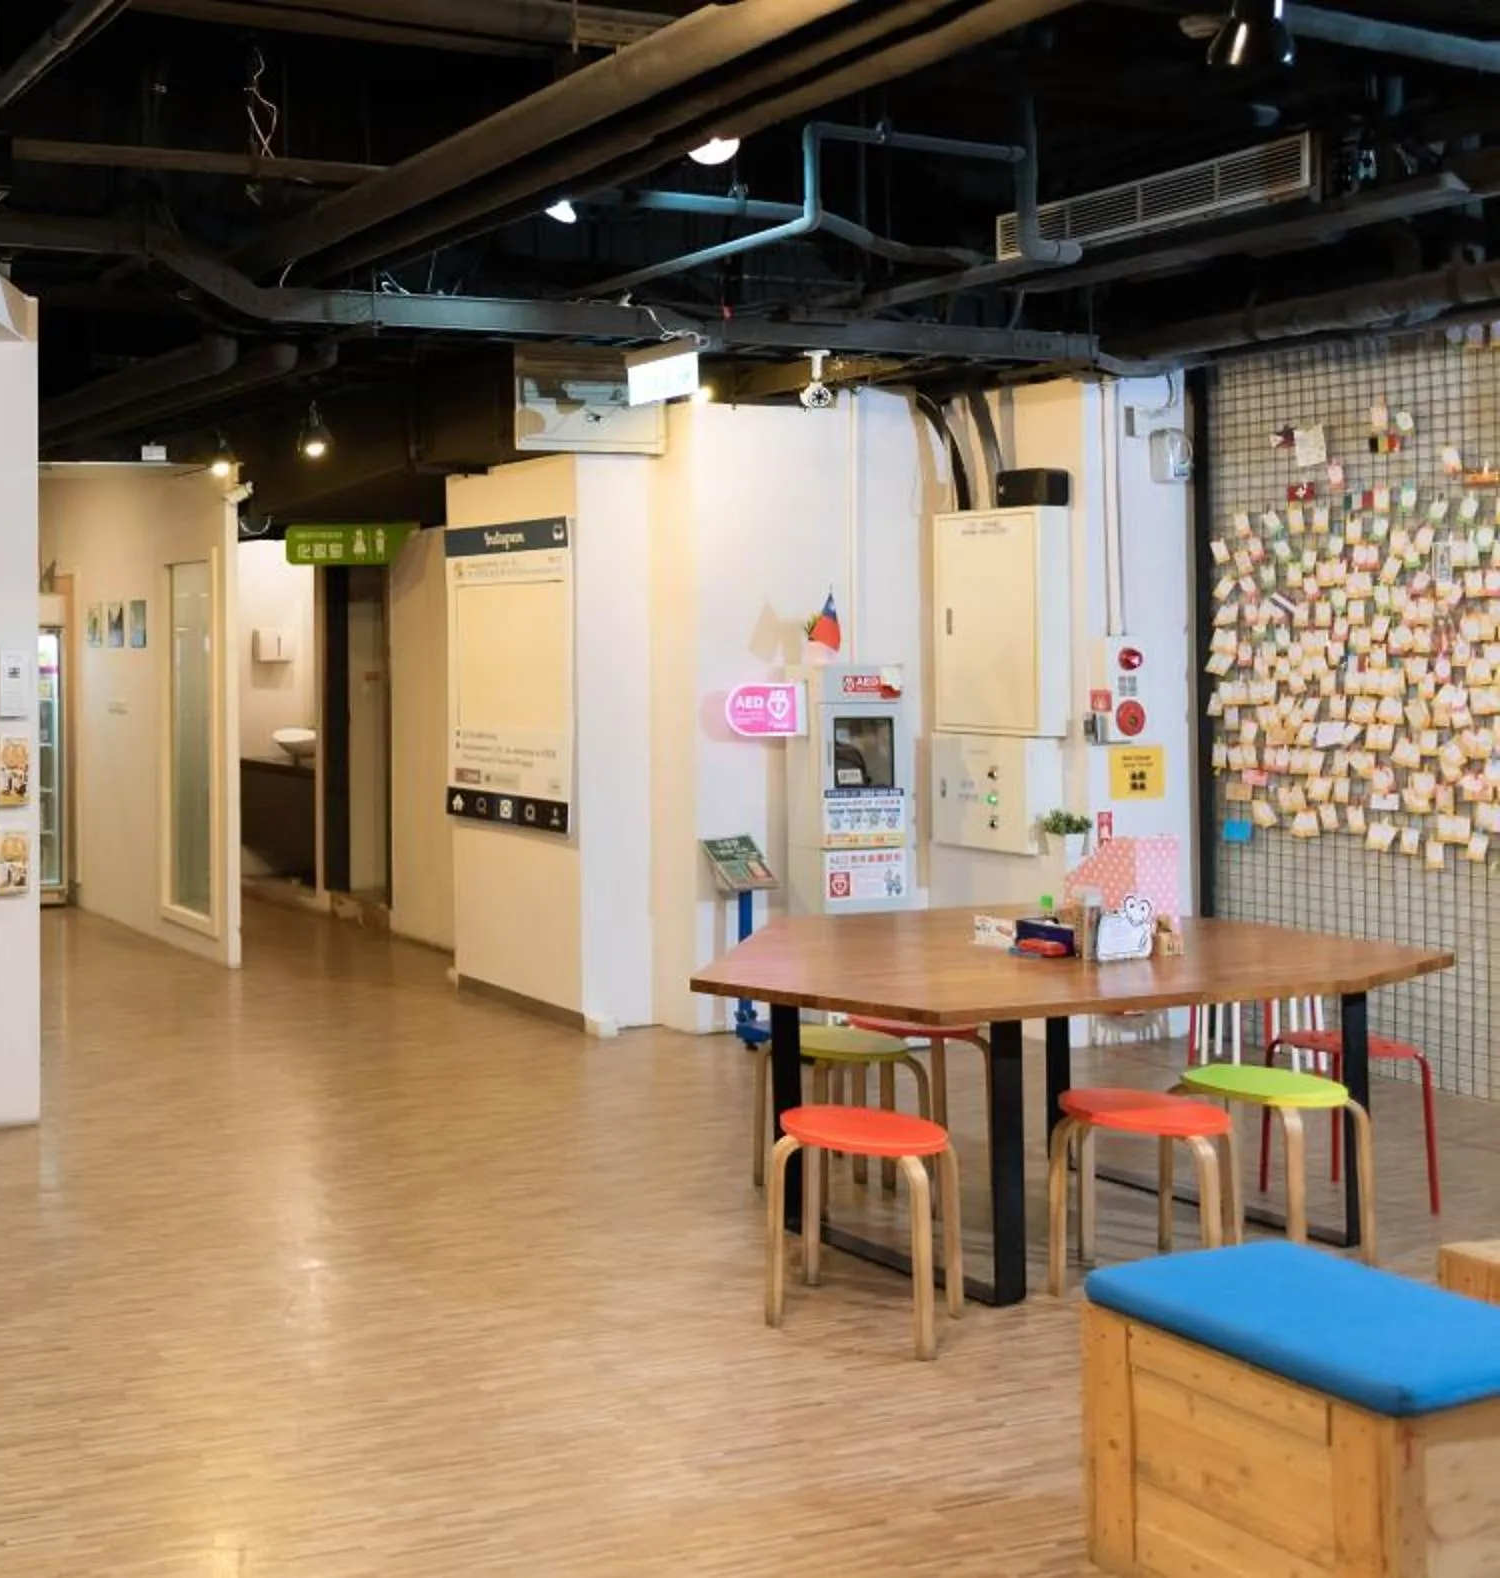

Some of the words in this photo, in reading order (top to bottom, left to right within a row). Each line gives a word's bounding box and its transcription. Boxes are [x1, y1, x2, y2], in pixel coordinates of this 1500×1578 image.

[483, 530, 525, 550] Instagram
[855, 677, 879, 687] AED
[735, 695, 765, 710] AED
